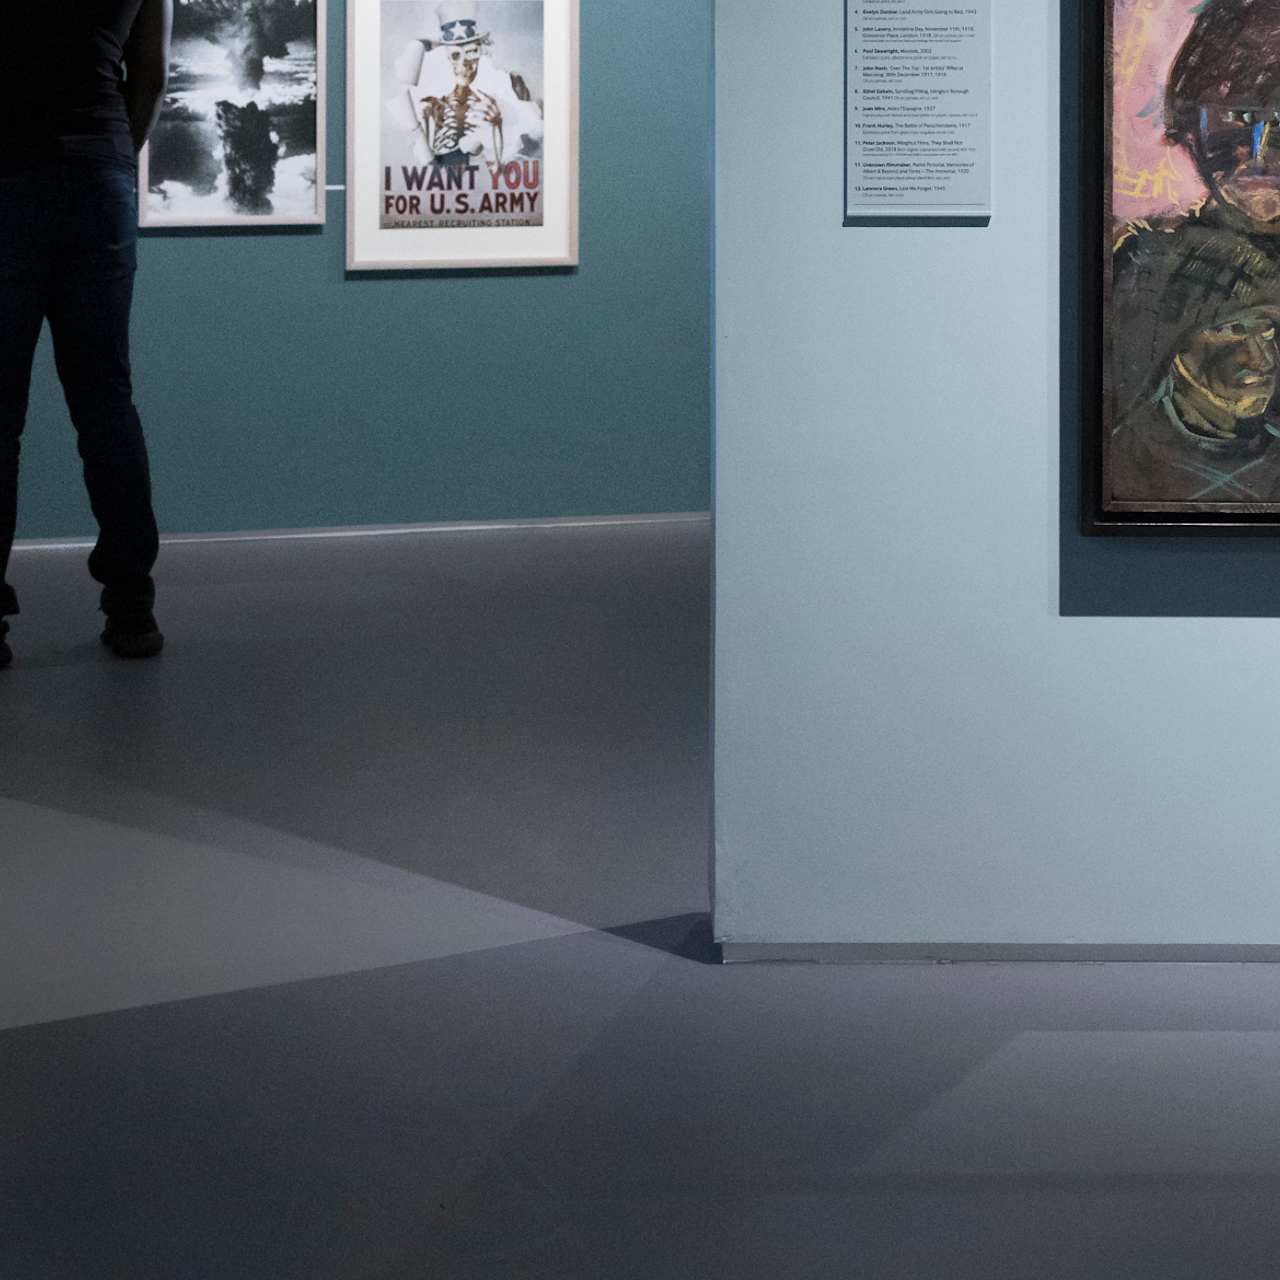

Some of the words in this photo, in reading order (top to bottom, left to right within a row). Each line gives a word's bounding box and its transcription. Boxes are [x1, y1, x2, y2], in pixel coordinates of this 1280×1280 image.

[384, 166, 391, 191] I
[401, 165, 479, 191] WANT
[489, 160, 539, 190] YOU
[384, 195, 421, 214] FOR
